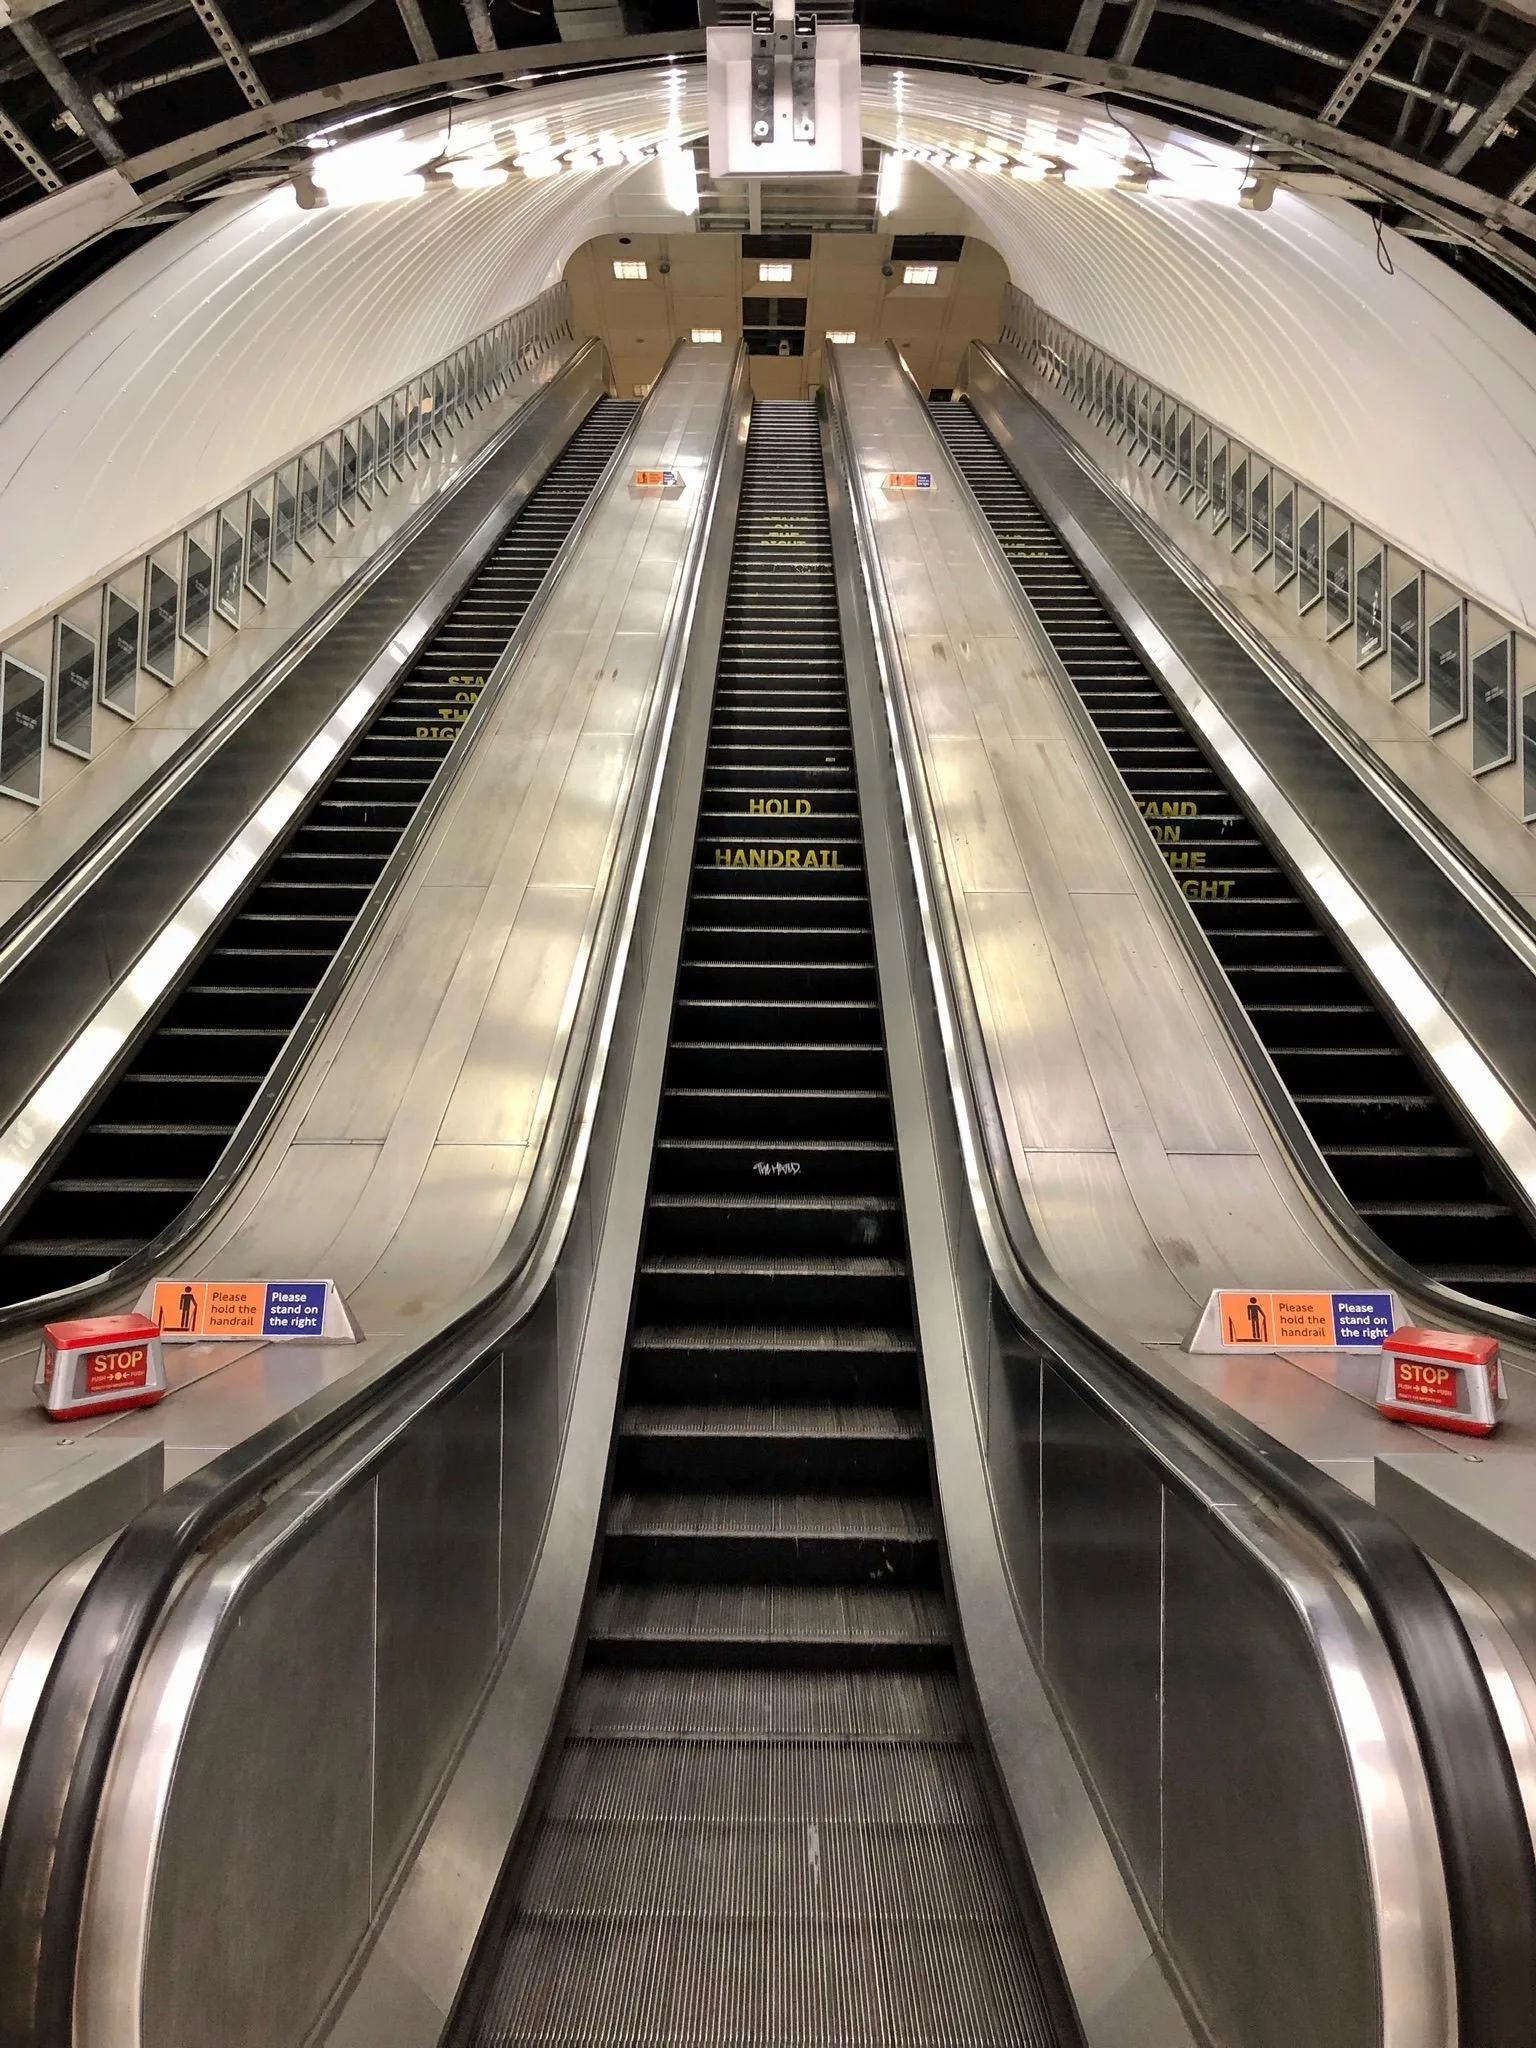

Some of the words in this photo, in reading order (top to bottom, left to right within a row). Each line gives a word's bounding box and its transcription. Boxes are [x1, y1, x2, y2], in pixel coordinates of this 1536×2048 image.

[438, 709, 470, 720] TH
[750, 799, 811, 816] HOLD
[1135, 801, 1197, 817] TAND
[715, 849, 844, 868] HANDRAIL
[1177, 880, 1235, 899] GHT
[212, 1292, 247, 1302] Please
[271, 1292, 307, 1302] Please
[211, 1305, 235, 1314] hold
[238, 1305, 257, 1314] the
[270, 1305, 301, 1314] stand
[304, 1306, 319, 1314] on
[1279, 1303, 1314, 1312] Please
[1338, 1303, 1374, 1313] Please
[209, 1317, 254, 1326] handrail
[269, 1317, 288, 1326] the
[291, 1317, 317, 1328] right
[1280, 1316, 1304, 1324] hold
[1307, 1316, 1326, 1324] the
[1340, 1316, 1370, 1325] stand
[1373, 1317, 1388, 1325] on
[1281, 1328, 1326, 1337] handrail
[1341, 1328, 1360, 1337] the
[1363, 1328, 1389, 1339] right
[94, 1351, 143, 1372] STOP
[1400, 1363, 1449, 1384] STOP
